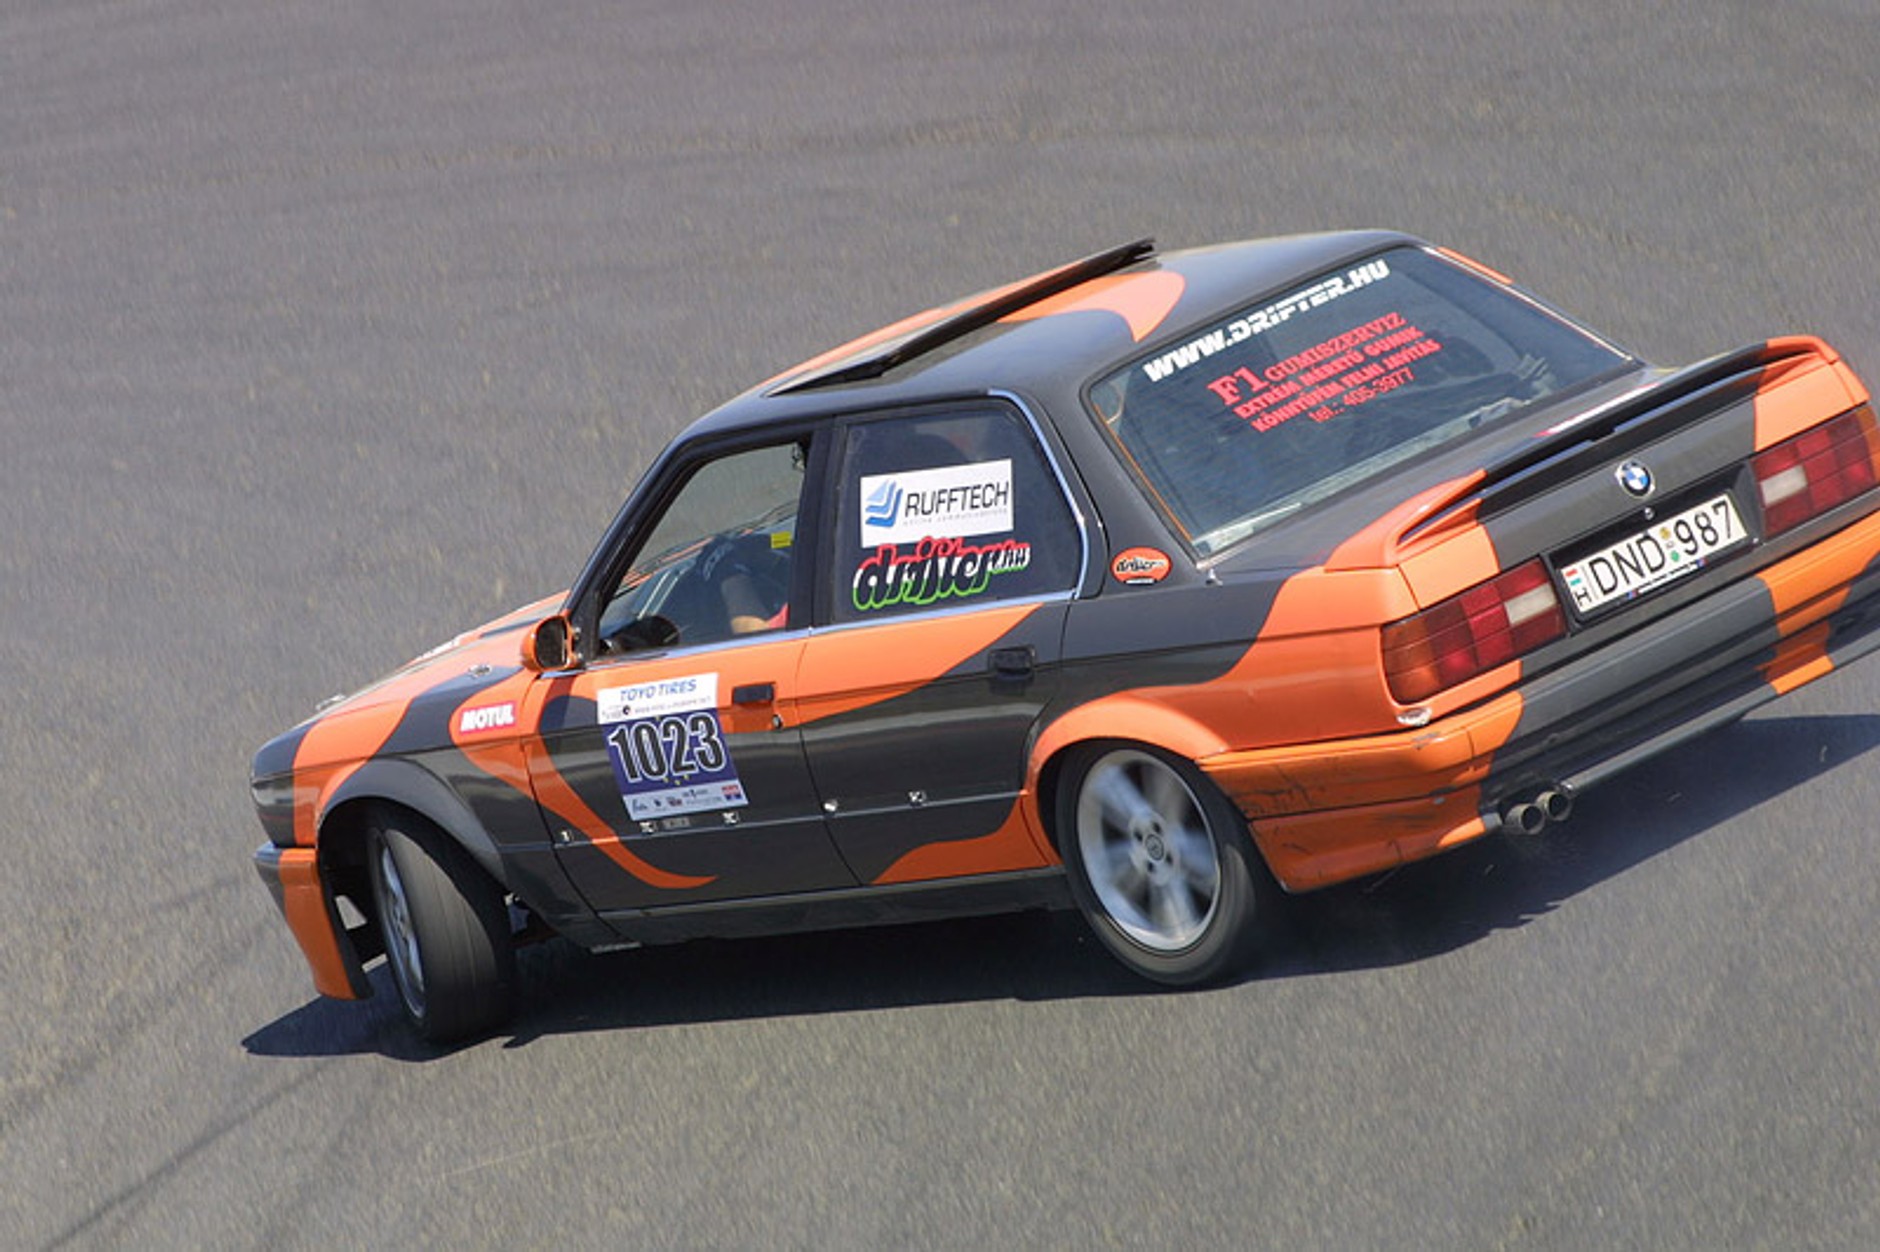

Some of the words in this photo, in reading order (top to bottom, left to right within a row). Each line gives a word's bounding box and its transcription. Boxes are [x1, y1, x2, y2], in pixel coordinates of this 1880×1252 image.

[1142, 258, 1390, 382] WWW.DRIFTER.HU
[1206, 366, 1270, 406] F1
[1263, 311, 1407, 381] GUMISZERVIZ
[904, 481, 1009, 518] RUFFTECH
[1673, 500, 1732, 555] 987
[460, 703, 515, 732] MOTUL
[620, 685, 656, 702] TOYO
[658, 679, 697, 699] TIRES
[607, 712, 727, 784] 1023
